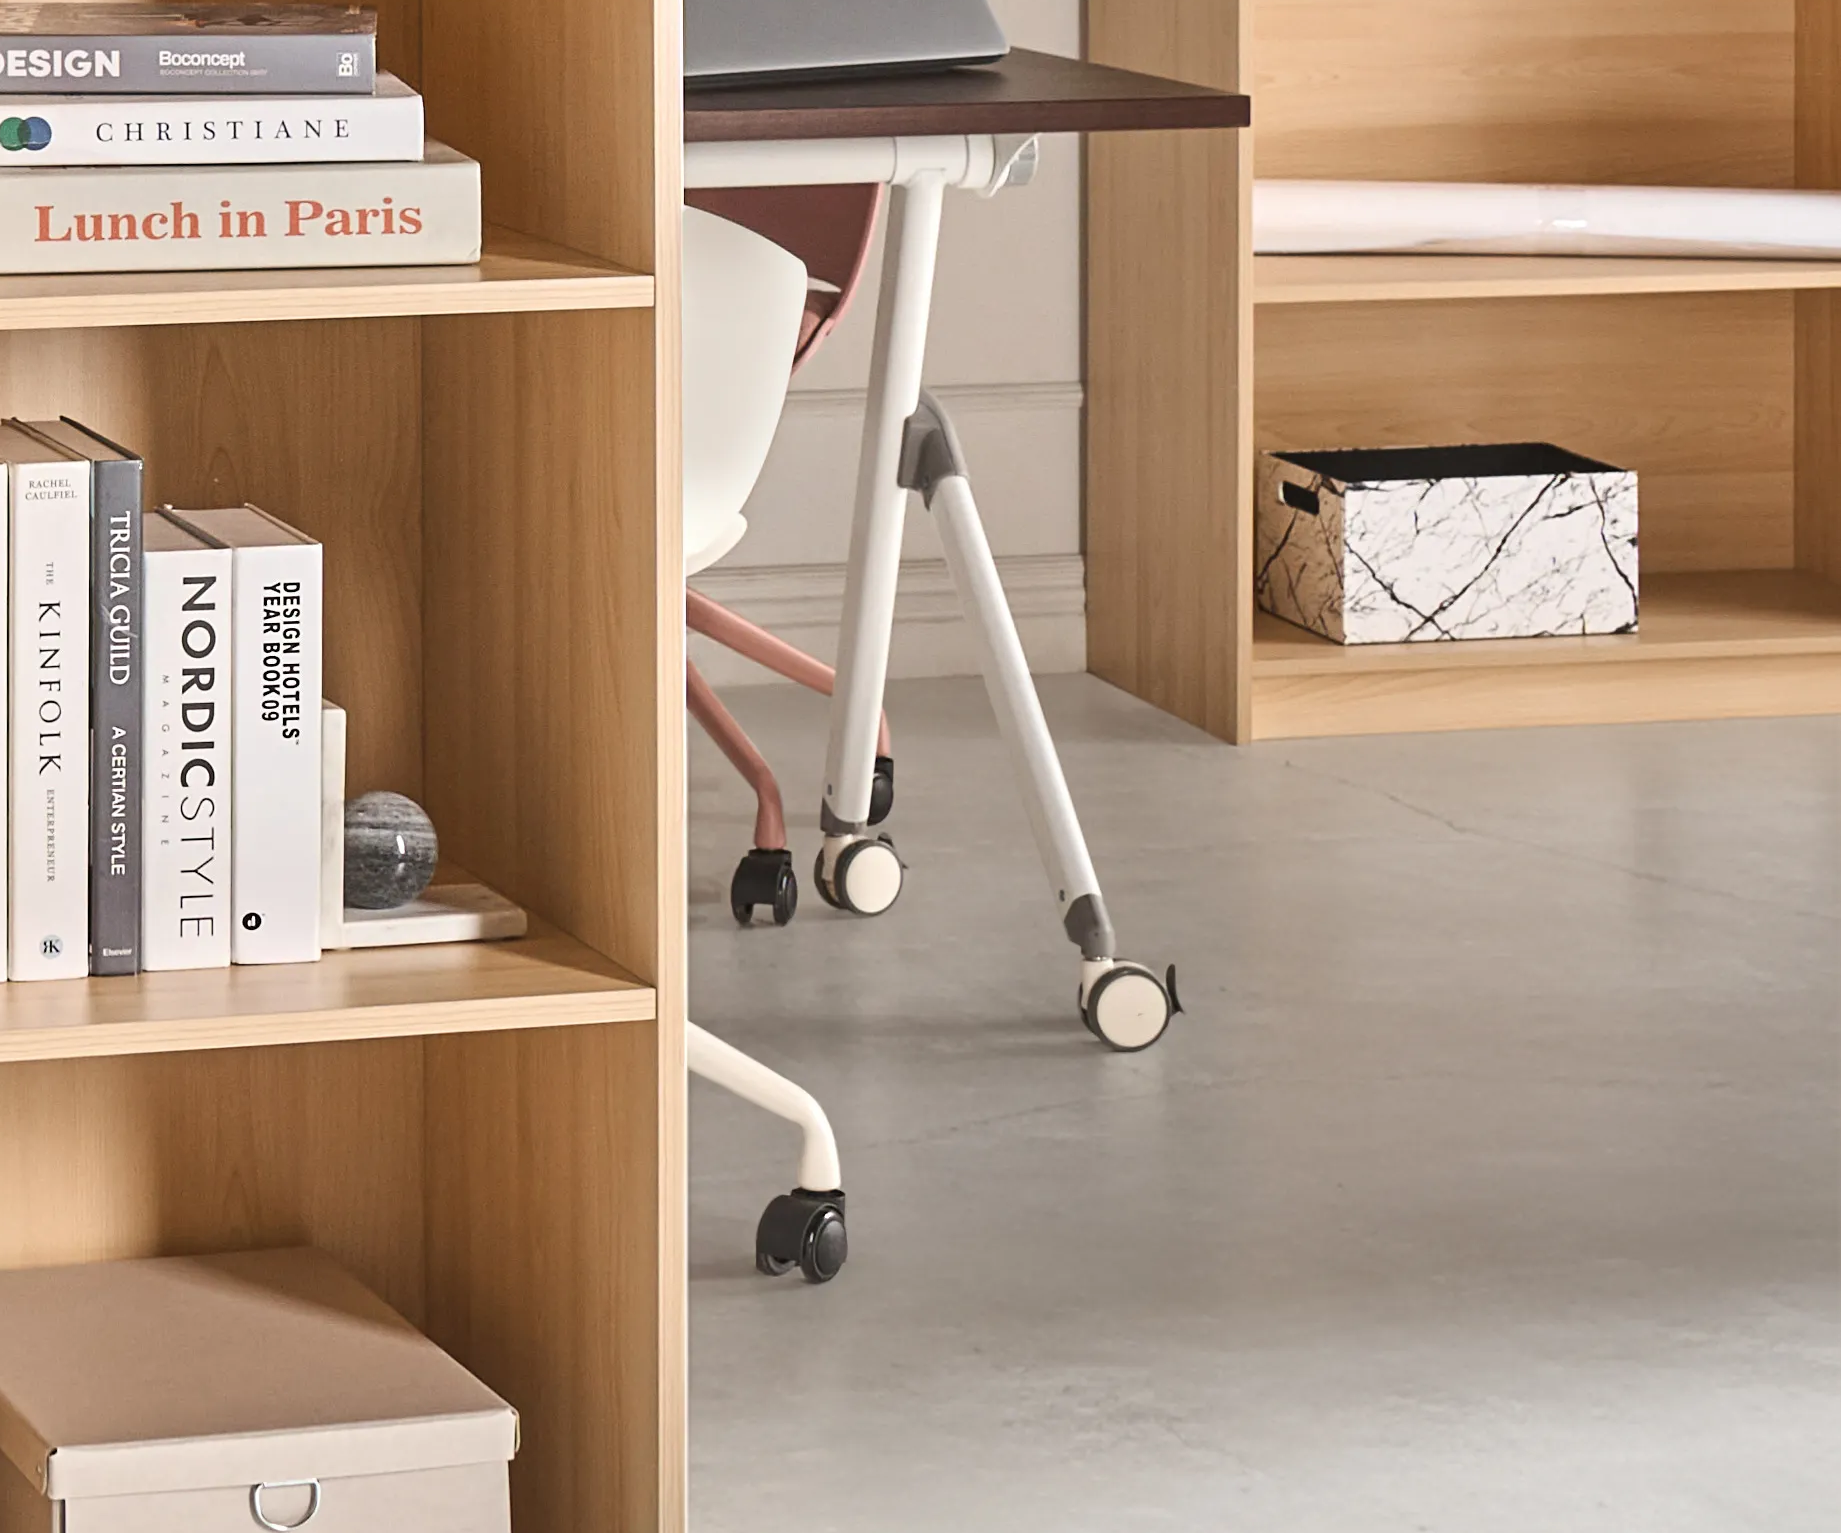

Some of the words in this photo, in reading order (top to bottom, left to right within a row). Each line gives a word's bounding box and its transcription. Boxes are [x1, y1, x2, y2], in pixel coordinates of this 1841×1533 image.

[160, 51, 245, 69] Boconcept
[97, 120, 348, 141] CHRISTIANE
[34, 202, 201, 242] Lunch
[219, 201, 267, 237] in
[285, 197, 422, 236] Paris
[24, 490, 78, 501] CAULFIEL
[28, 478, 72, 489] RACHEL
[45, 561, 54, 586] THE
[108, 511, 133, 600] TRICIA
[263, 582, 280, 633] YEAR
[283, 582, 300, 653] DESIGN
[108, 604, 133, 686] GUILD
[38, 601, 62, 776] KINFOLK
[112, 727, 126, 739] A
[180, 576, 216, 937] NORDICSTYLE
[112, 744, 126, 817] CERTIAN
[160, 674, 170, 847] MAGAZINE
[46, 789, 56, 882] ENTERPRENEUR
[111, 823, 125, 875] STYLE
